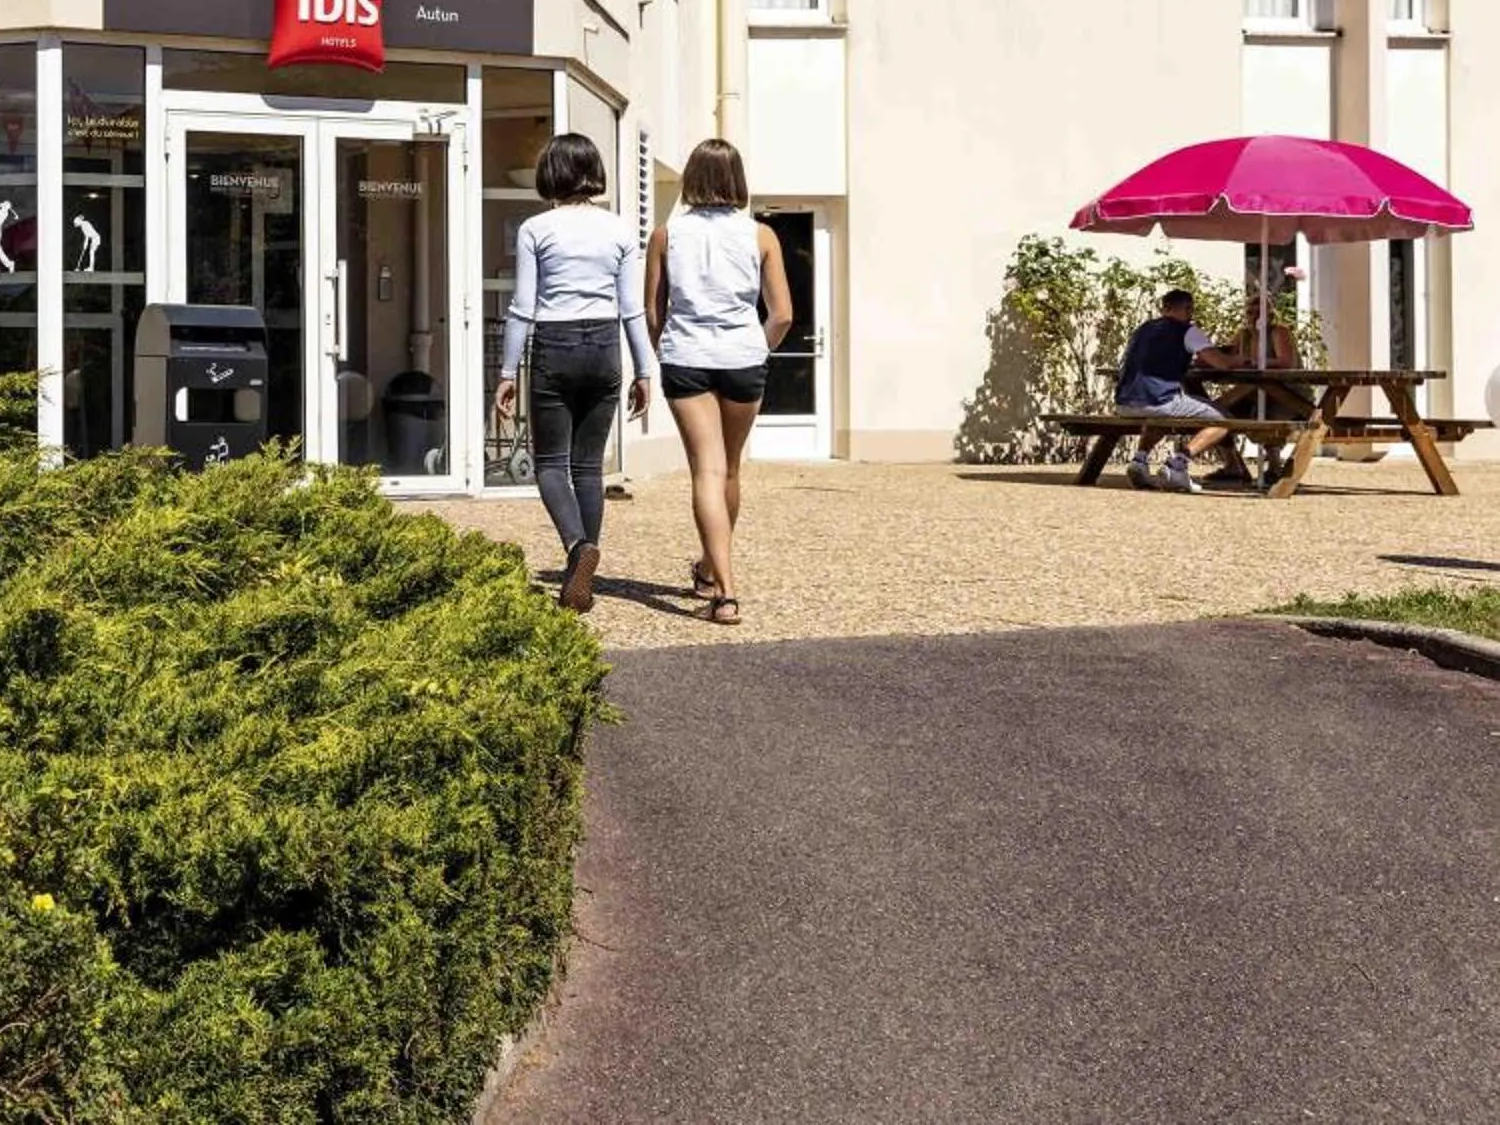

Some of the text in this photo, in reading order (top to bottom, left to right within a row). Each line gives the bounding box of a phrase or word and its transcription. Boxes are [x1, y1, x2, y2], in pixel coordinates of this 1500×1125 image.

[416, 5, 459, 23] Autun
[321, 37, 357, 48] HOTELS
[211, 174, 279, 188] BIENVENUE
